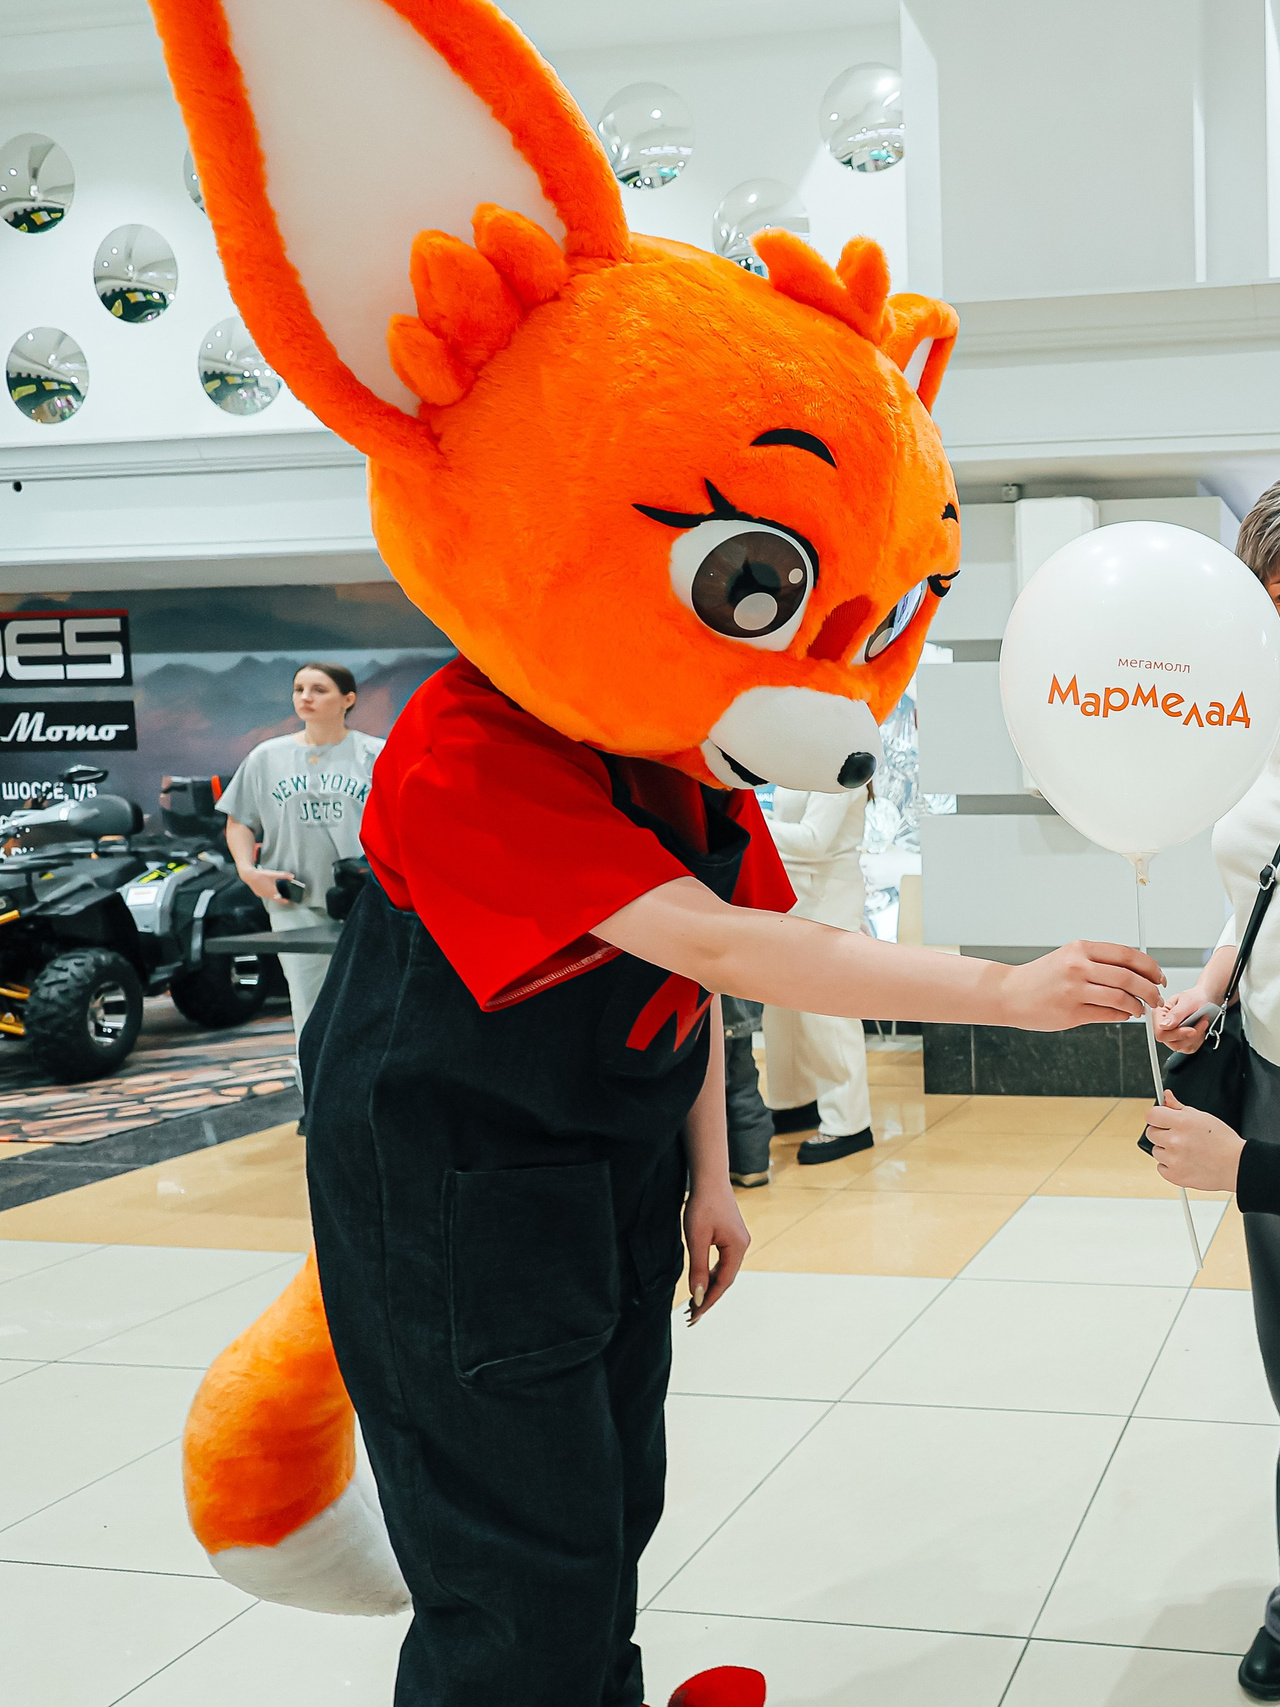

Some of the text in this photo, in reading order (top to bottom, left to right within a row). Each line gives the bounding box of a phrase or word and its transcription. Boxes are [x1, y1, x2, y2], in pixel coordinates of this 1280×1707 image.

[0, 618, 125, 680] ES
[1117, 656, 1191, 674] мегамолл
[271, 772, 371, 807] NEW YORK
[299, 801, 343, 821] JETS
